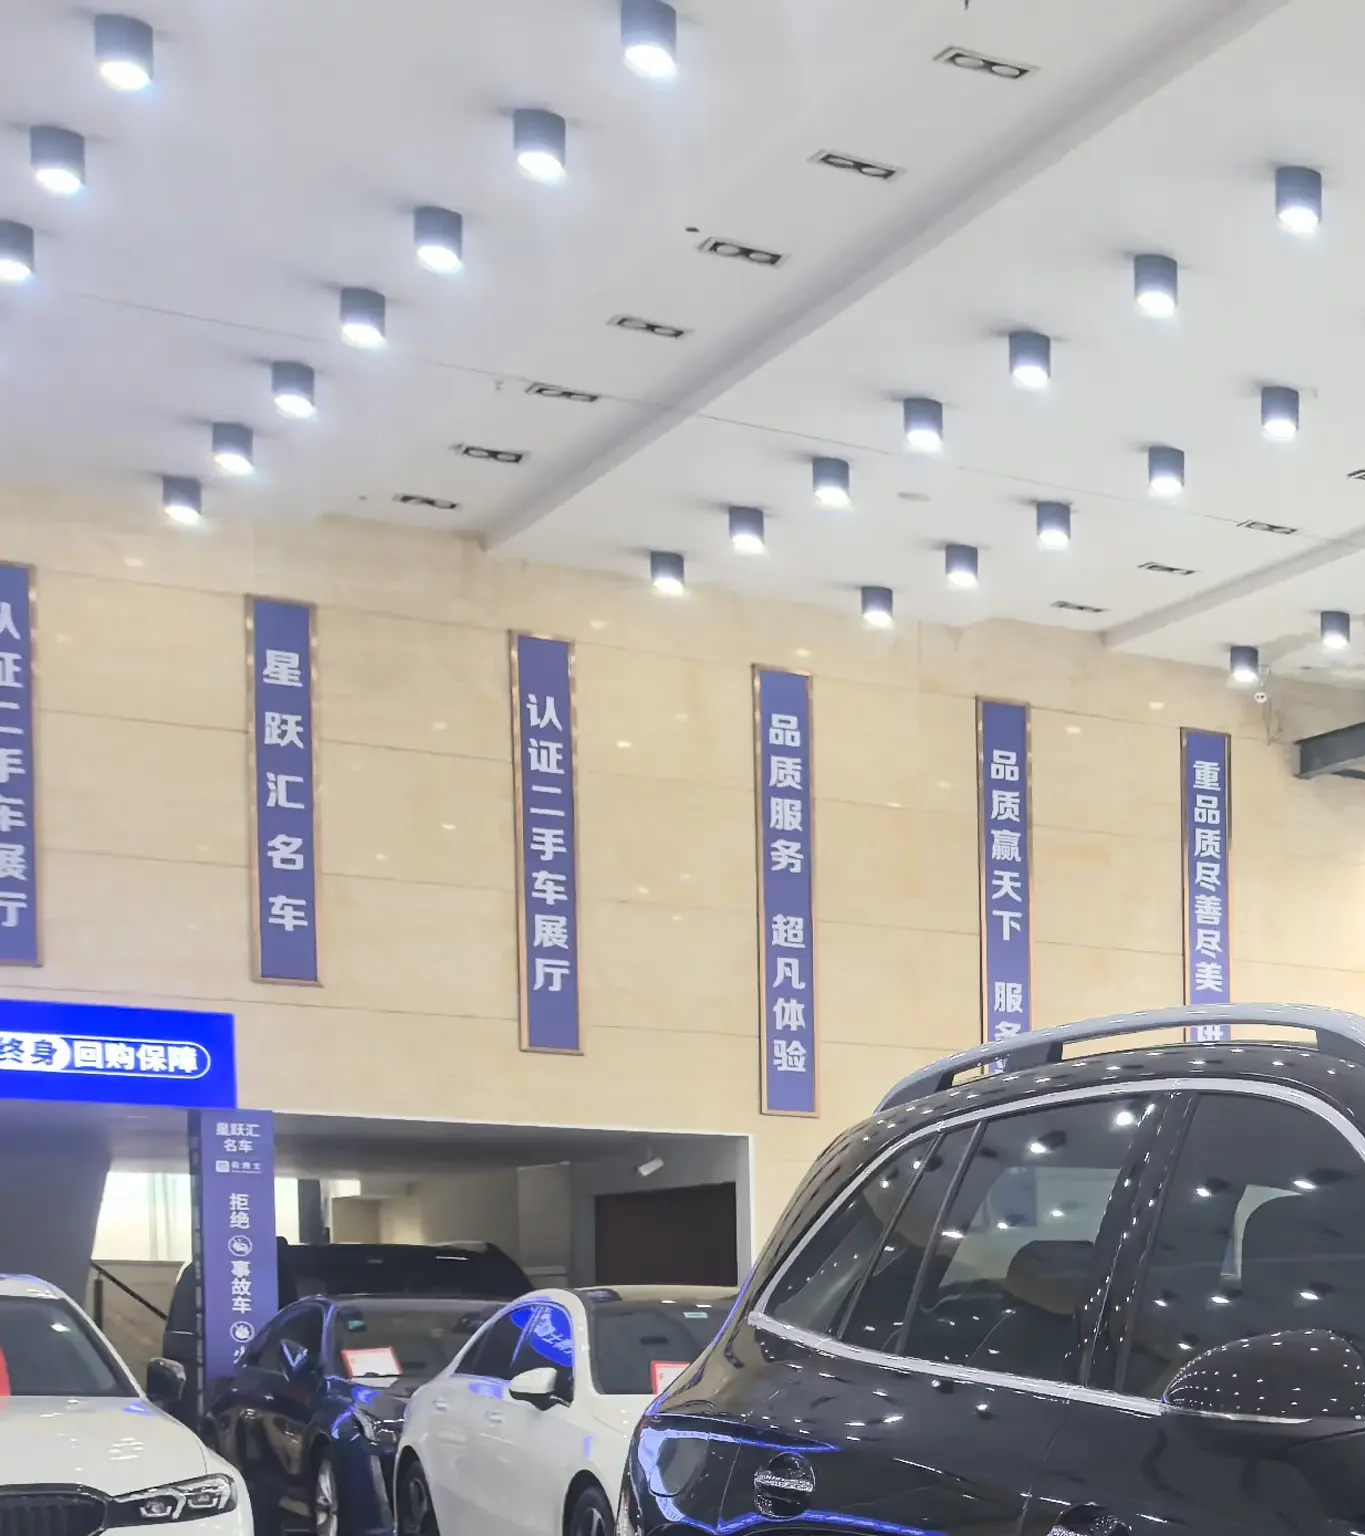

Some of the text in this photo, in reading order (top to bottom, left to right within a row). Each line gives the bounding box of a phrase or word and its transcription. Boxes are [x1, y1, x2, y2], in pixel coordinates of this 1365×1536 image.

[263, 650, 308, 931] 星跃汇名车
[526, 694, 570, 991] 认证二手车展厅
[990, 750, 1022, 941] 品质赢天下
[1193, 761, 1222, 992] 重品质尽善尽美
[768, 714, 807, 1072] 品质服务 超凡体验
[216, 1122, 260, 1137] 星跃汇
[224, 1138, 254, 1153] 名车
[229, 1193, 250, 1229] 拒绝
[231, 1260, 252, 1314] 事故车
